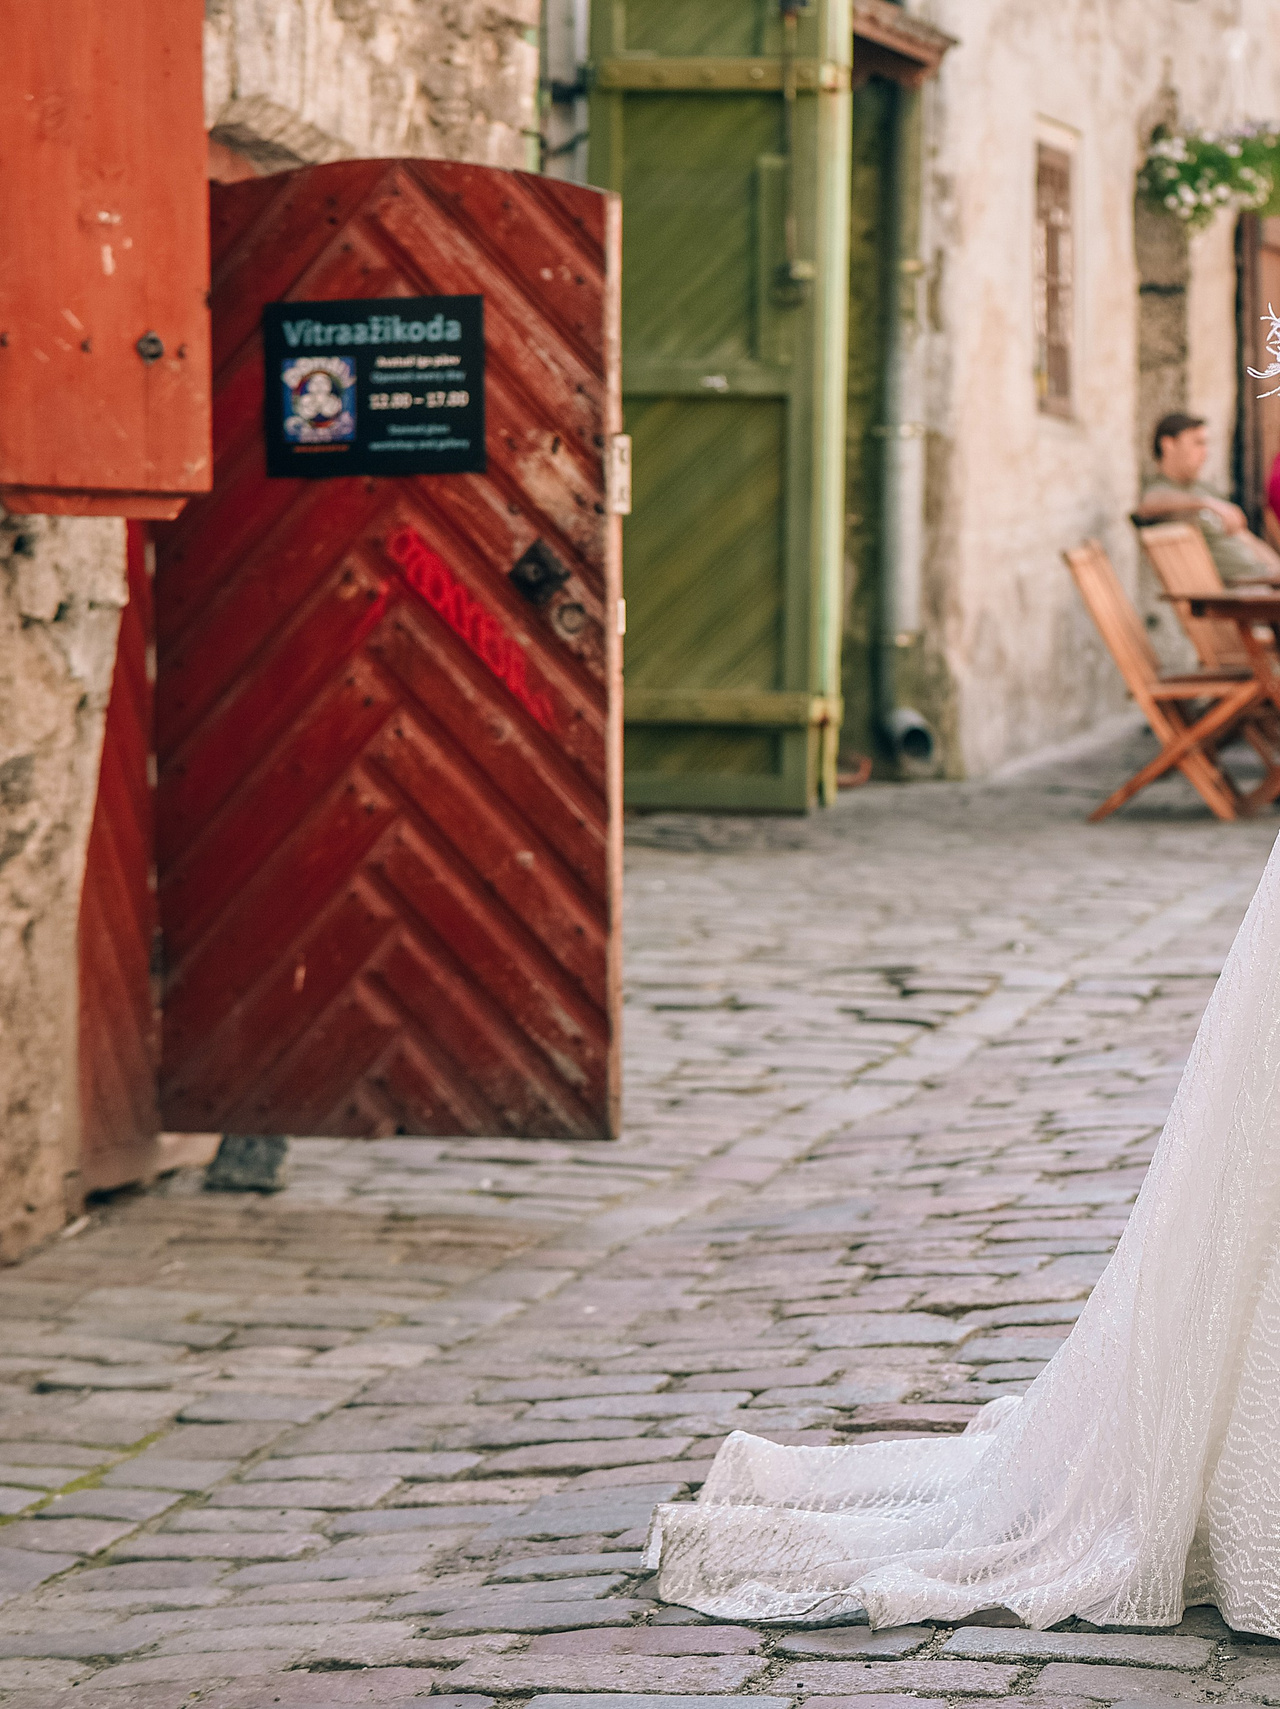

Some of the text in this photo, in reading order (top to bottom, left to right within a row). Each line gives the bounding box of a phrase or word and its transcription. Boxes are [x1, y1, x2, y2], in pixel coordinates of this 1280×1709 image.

[282, 313, 462, 348] Vitraažikoda
[370, 392, 413, 410] 12.00
[426, 390, 470, 408] 17.00
